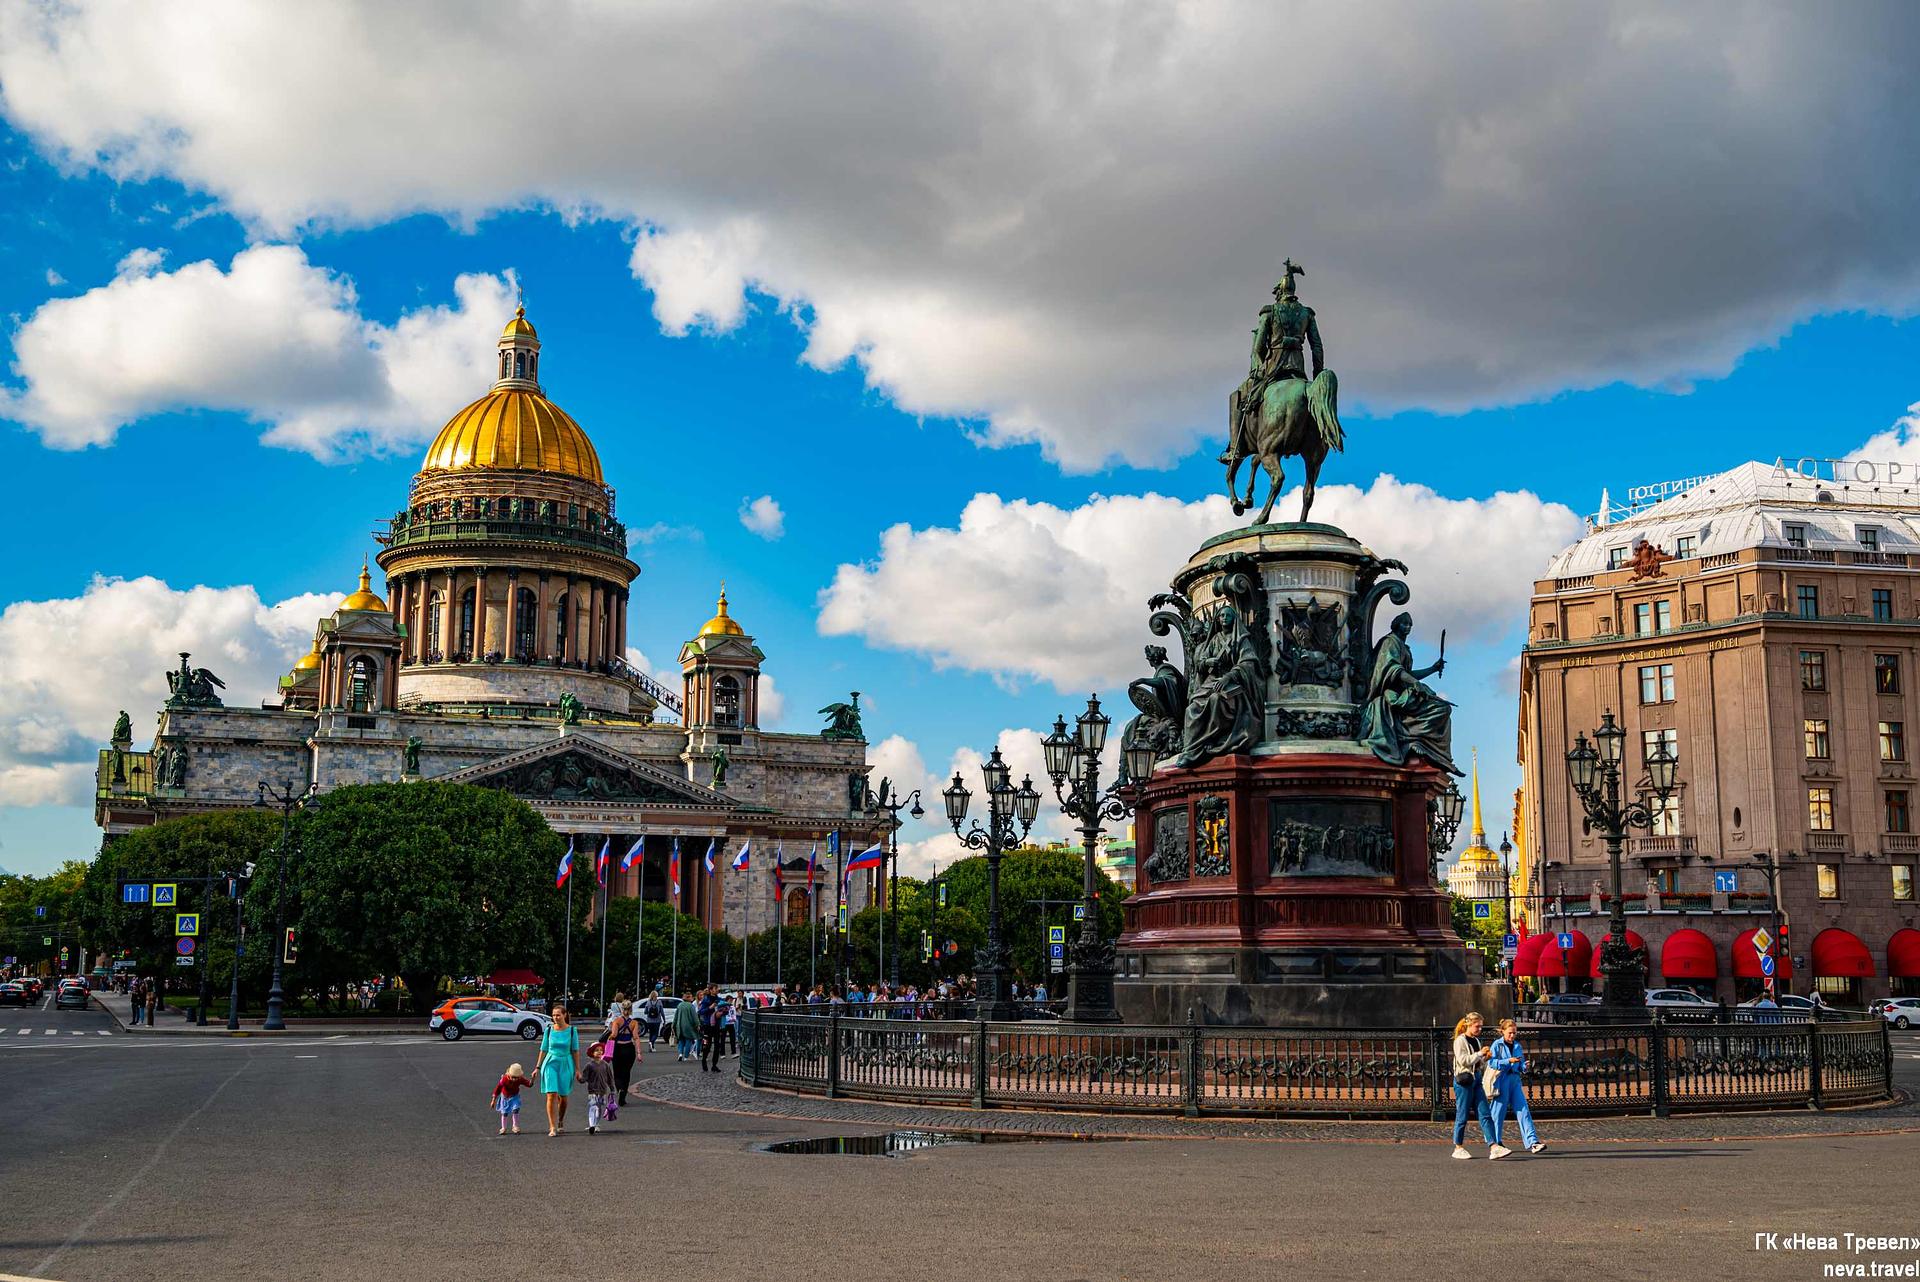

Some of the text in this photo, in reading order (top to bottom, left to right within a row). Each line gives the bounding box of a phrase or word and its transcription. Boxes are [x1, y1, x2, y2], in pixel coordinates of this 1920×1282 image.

[1628, 472, 1723, 500] ГОСТИНИ
[1562, 637, 1740, 667] HOTEL ASTORIA HOTEL
